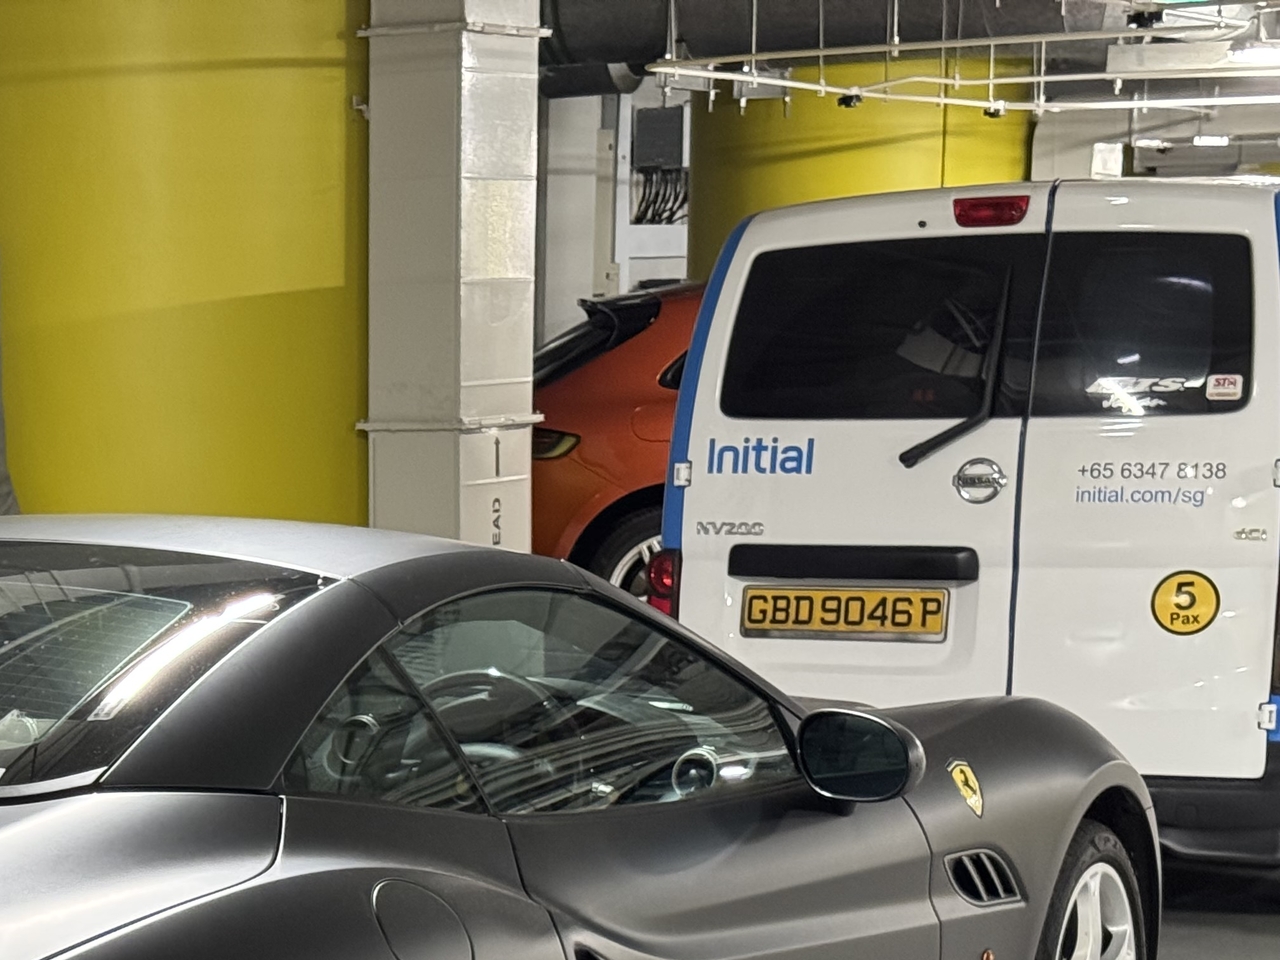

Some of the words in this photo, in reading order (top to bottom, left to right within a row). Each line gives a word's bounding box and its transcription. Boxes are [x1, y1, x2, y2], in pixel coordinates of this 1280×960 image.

[706, 437, 815, 475] Initial
[1077, 462, 1114, 480] +65
[1120, 462, 1170, 480] 6347
[1176, 462, 1227, 480] 8138
[1075, 486, 1205, 508] initial.com/sg
[1173, 581, 1197, 611] 5
[747, 595, 942, 628] GBD9046P
[1169, 612, 1200, 626] Pax
